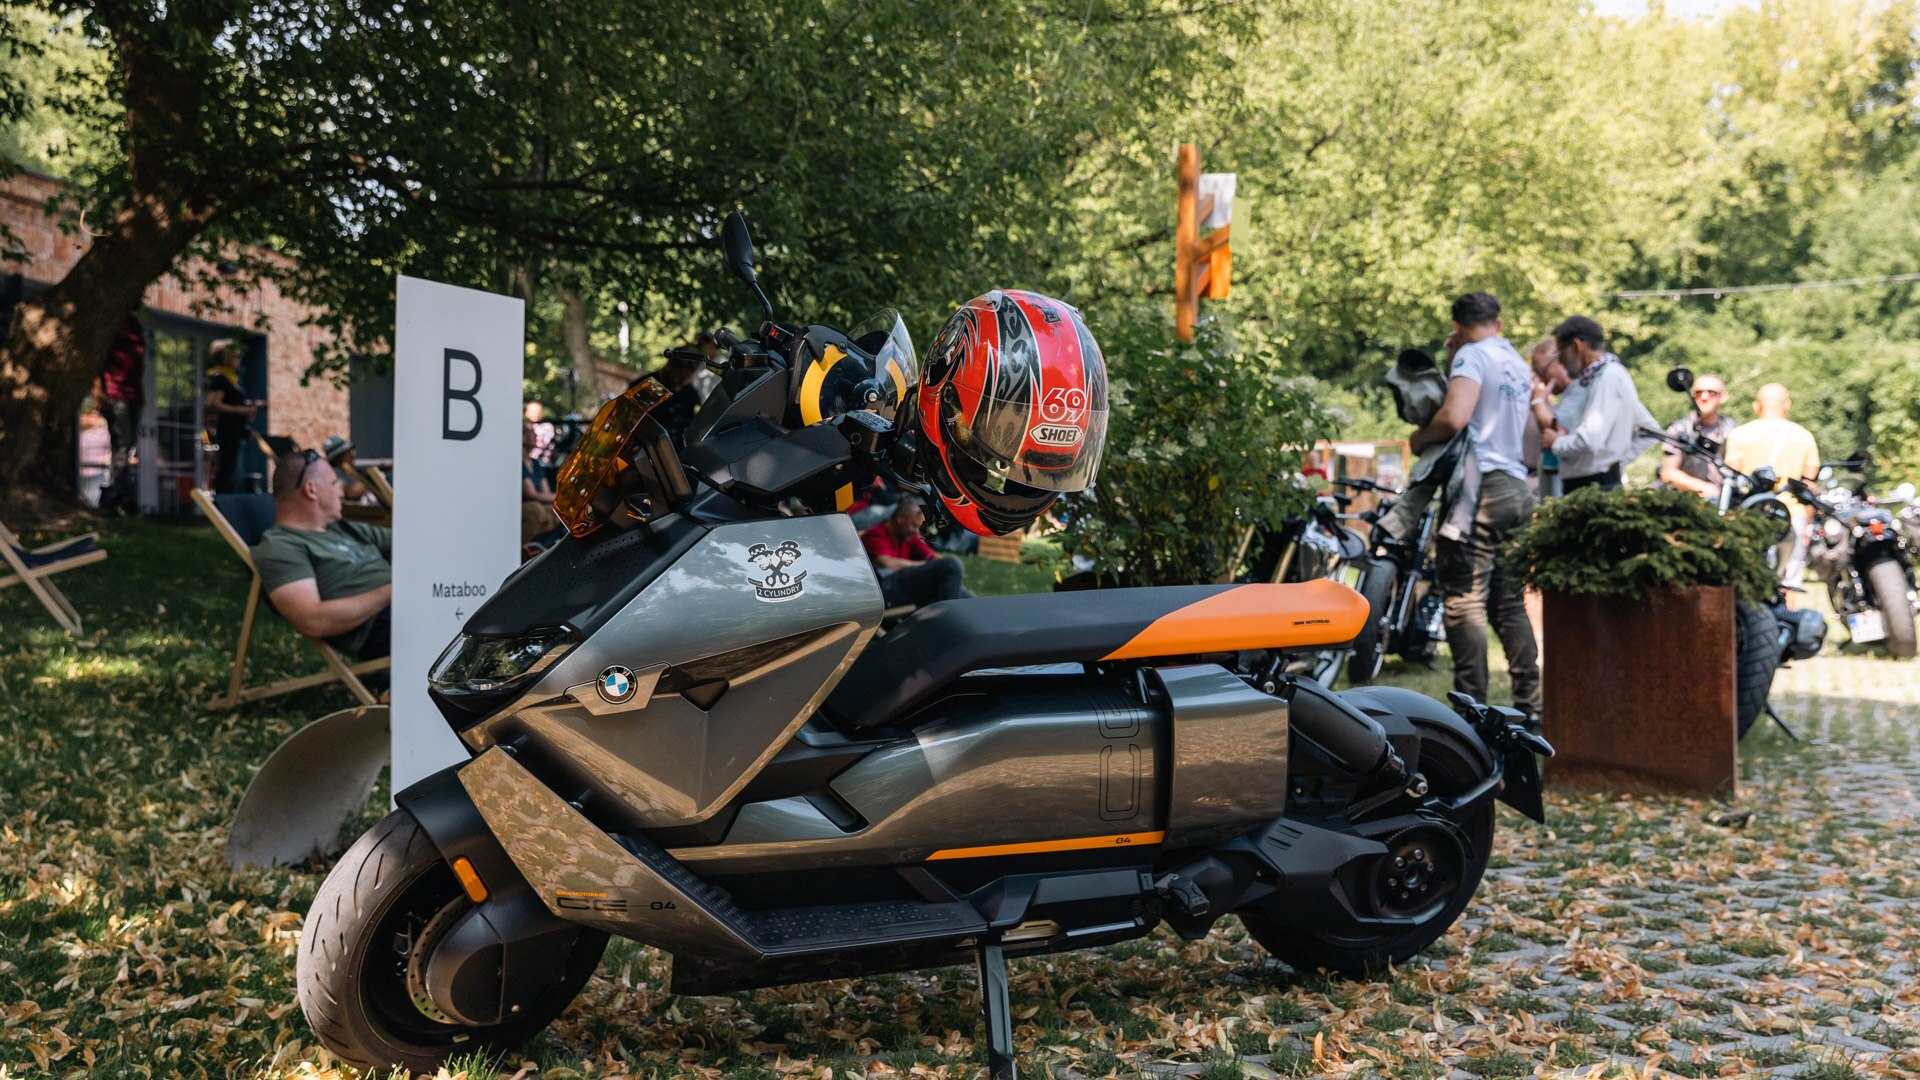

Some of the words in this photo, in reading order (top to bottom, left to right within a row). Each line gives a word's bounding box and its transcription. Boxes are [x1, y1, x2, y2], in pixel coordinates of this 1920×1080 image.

[443, 347, 483, 441] B
[1041, 387, 1087, 422] 69
[1039, 428, 1077, 442] SHOEI
[432, 581, 487, 598] Mataboo
[757, 588, 763, 596] 2
[764, 585, 800, 597] CYLINDRY
[556, 897, 628, 912] CE
[650, 901, 677, 910] 04
